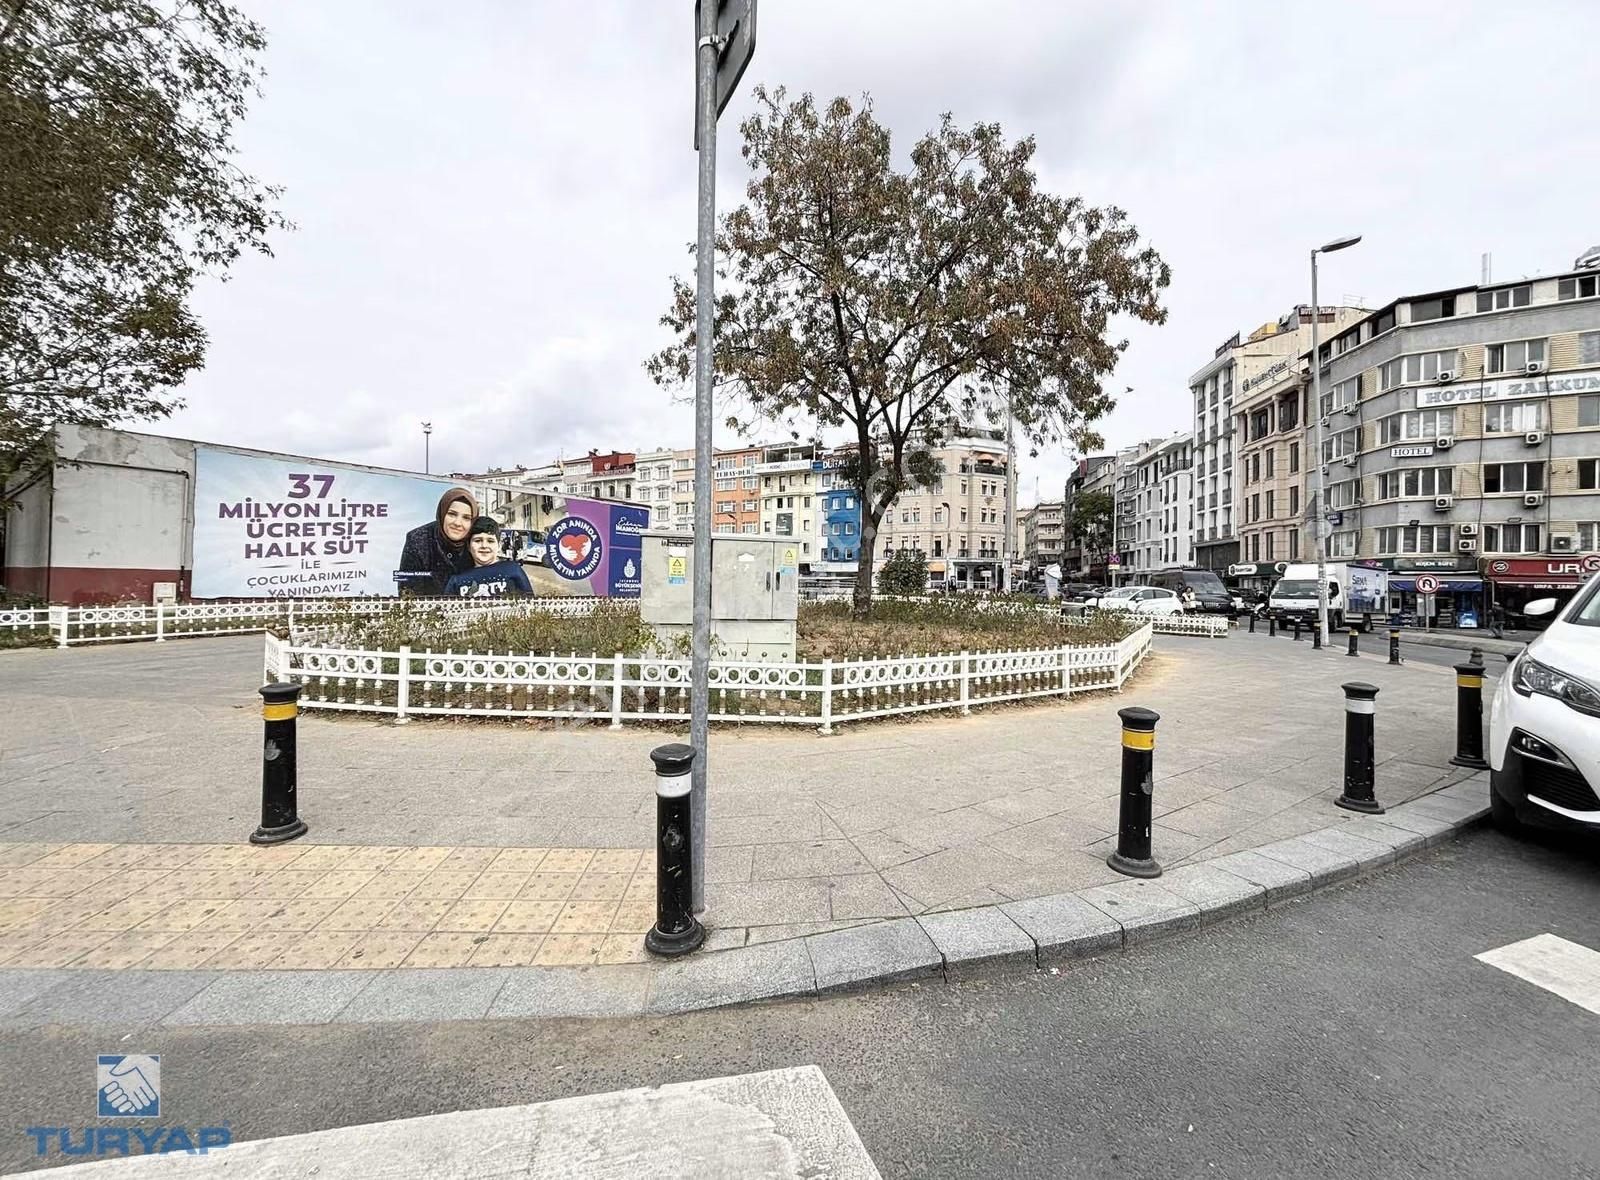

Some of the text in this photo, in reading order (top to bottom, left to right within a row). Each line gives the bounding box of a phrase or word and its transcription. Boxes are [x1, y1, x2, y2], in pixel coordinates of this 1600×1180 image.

[1424, 386, 1496, 404] HOTEL
[1394, 447, 1430, 456] HOTEL
[287, 473, 335, 499] 37
[219, 497, 388, 519] MİLYON LİTRE
[246, 517, 368, 539] ÜCRETSİZ
[552, 519, 597, 541] ZOR ANINDA
[244, 536, 369, 559] HALK SÜT
[301, 558, 321, 570] İLE
[576, 546, 600, 577] YANINDA
[247, 569, 367, 588] ÇOCUKLARIMIZIN
[268, 583, 350, 598] YANINDAYIZ
